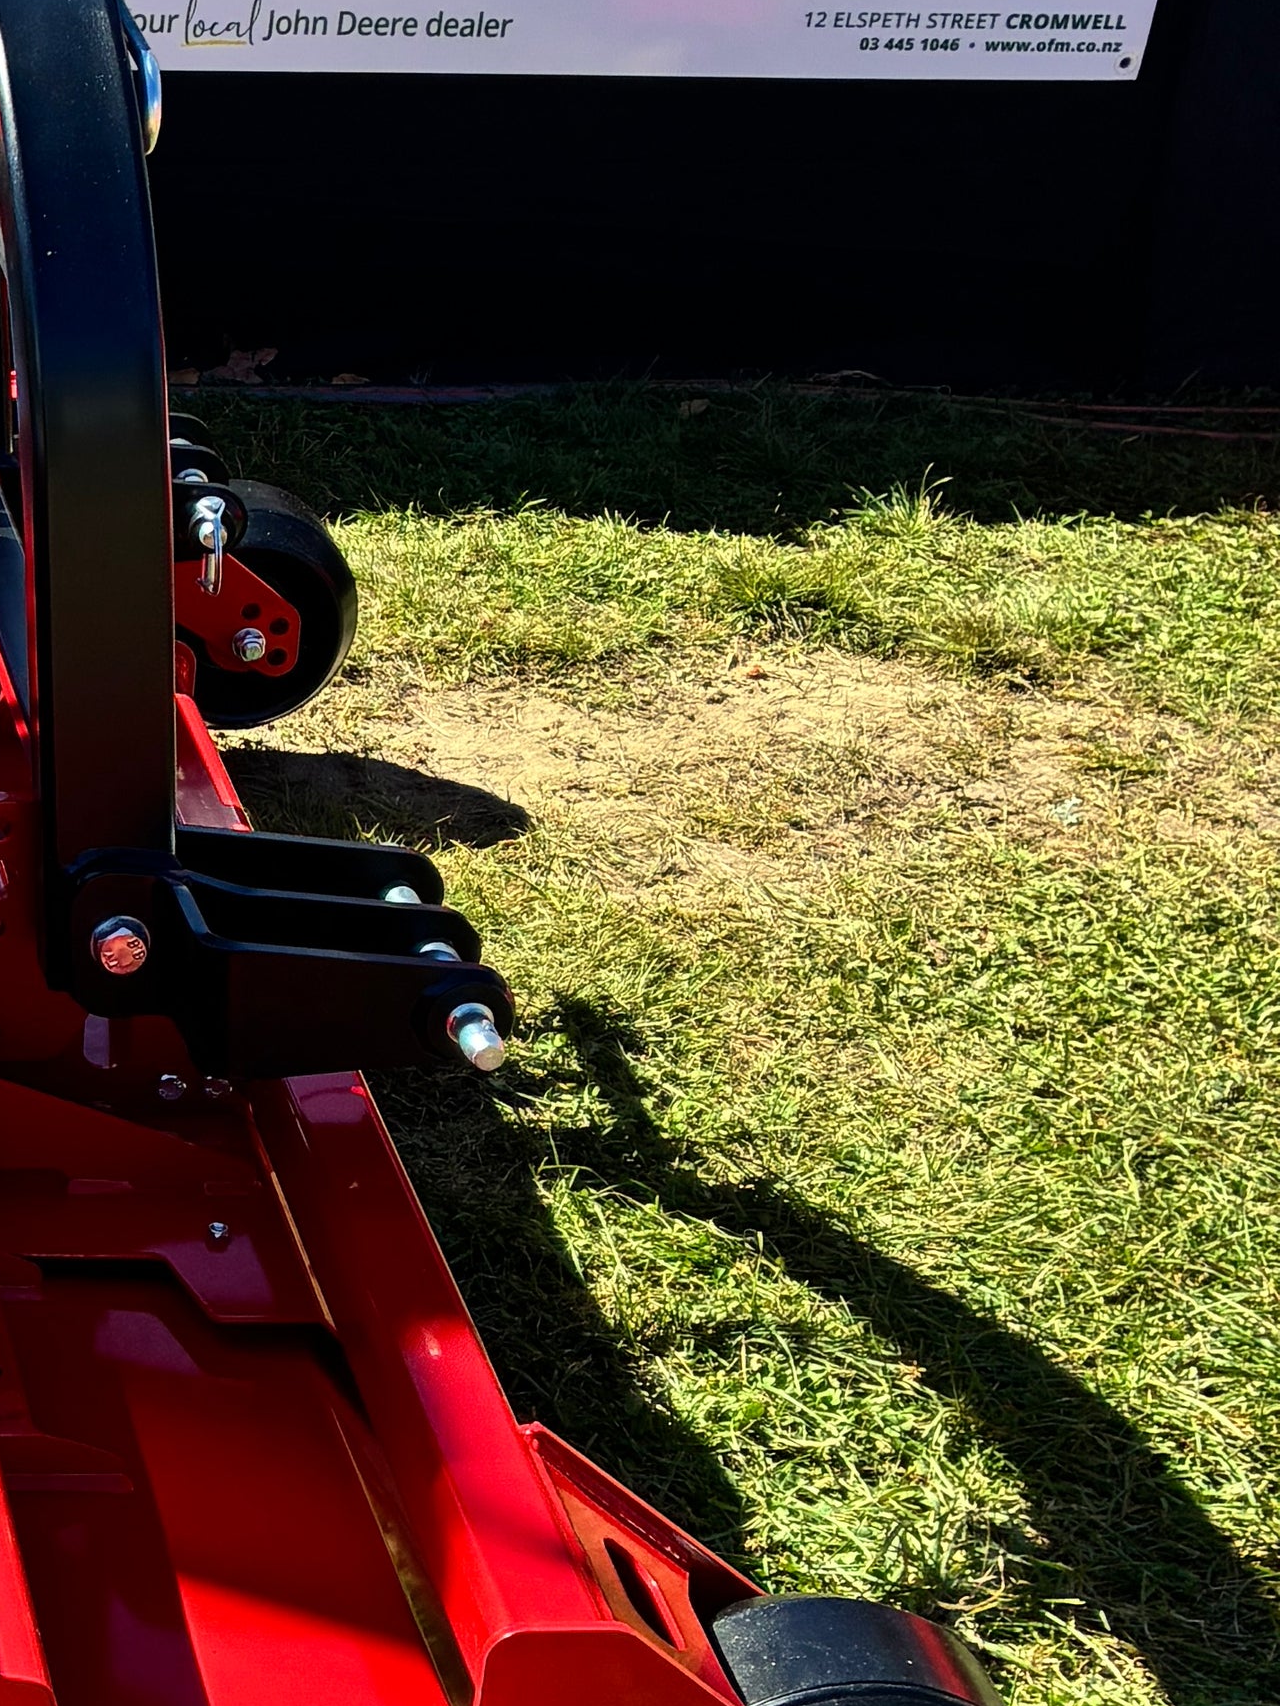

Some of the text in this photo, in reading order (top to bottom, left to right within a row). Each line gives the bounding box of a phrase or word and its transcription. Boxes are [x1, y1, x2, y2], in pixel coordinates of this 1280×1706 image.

[130, 9, 179, 34] our
[262, 9, 328, 41] John
[338, 11, 418, 37] Deere
[425, 11, 513, 38] dealer
[804, 12, 1128, 30] 12 ELSPETH STREET CROMWELL
[859, 37, 1123, 53] 03 445 1046 www.ofm.co.nz
